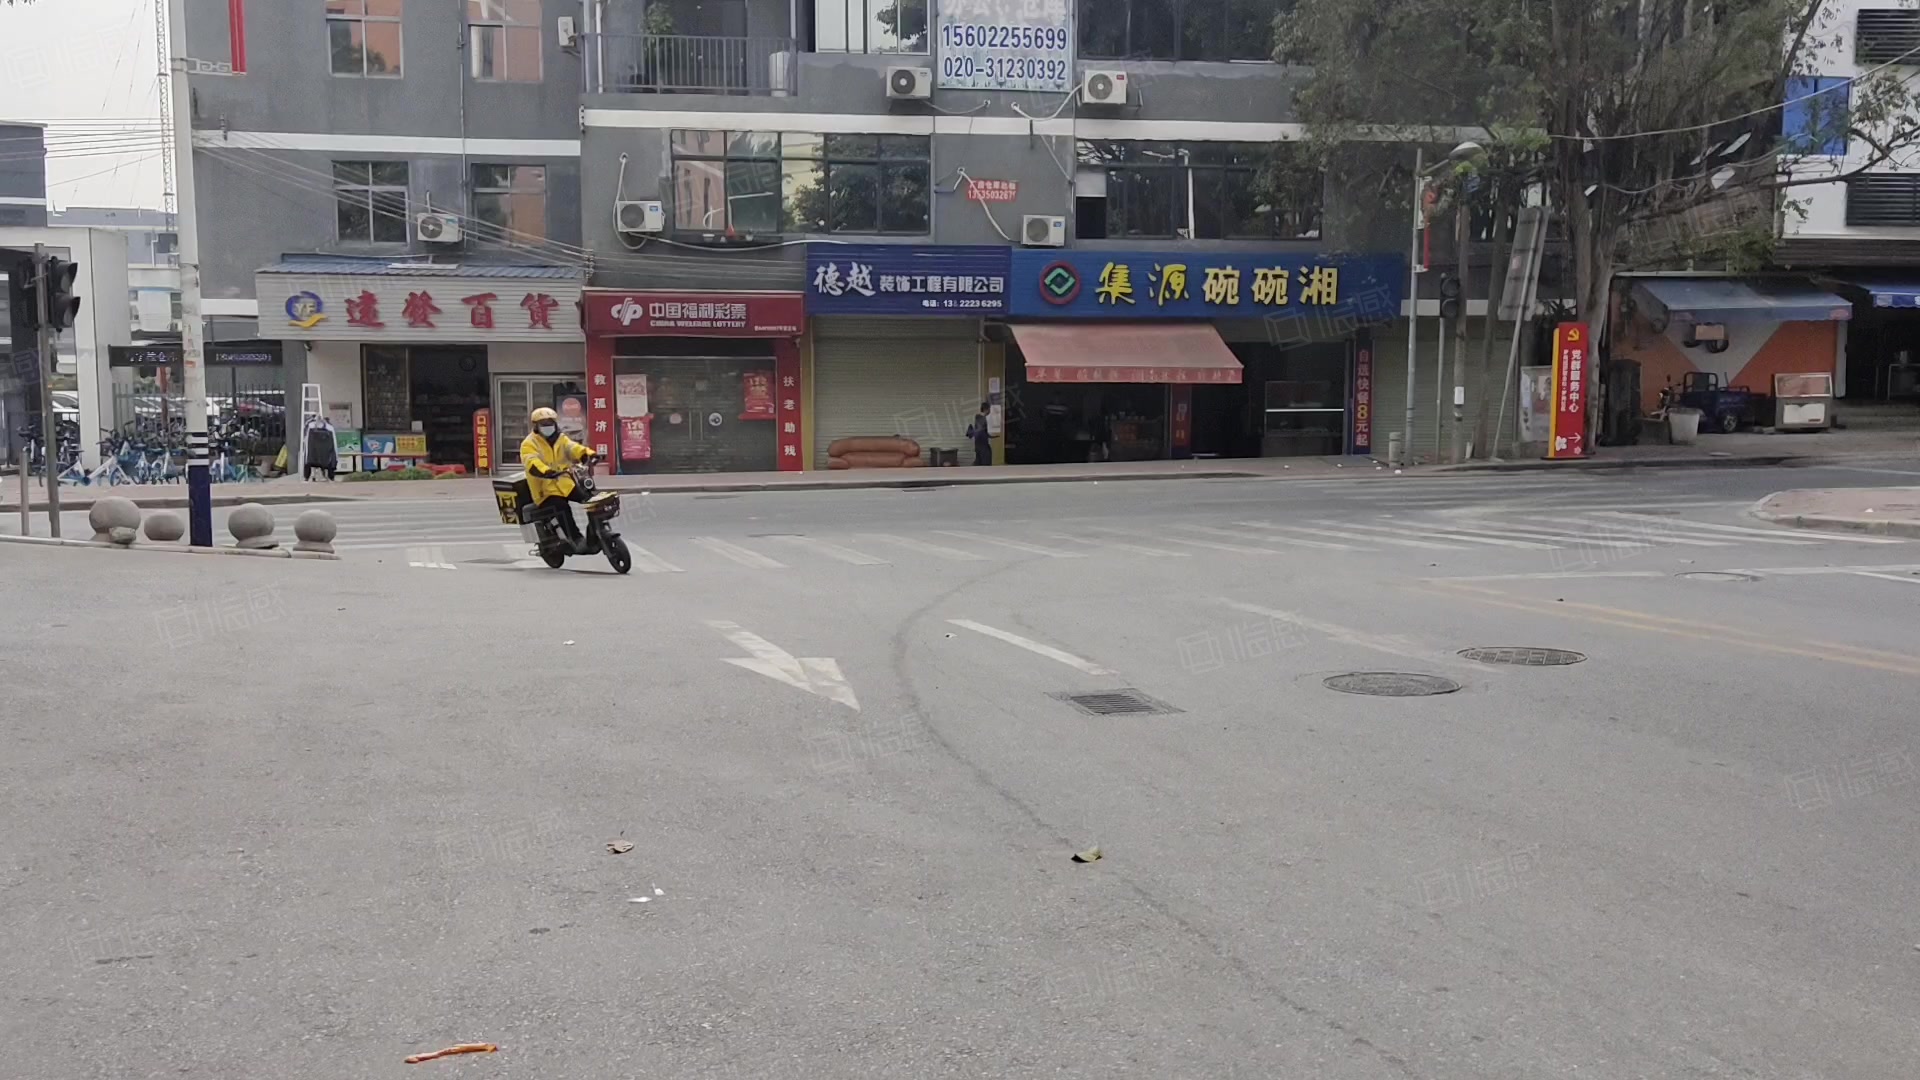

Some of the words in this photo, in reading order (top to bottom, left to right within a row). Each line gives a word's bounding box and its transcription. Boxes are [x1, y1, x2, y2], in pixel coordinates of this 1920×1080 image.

[942, 25, 1067, 50] 15602255699
[943, 57, 1067, 80] 020-31230392
[879, 275, 1004, 294] 装饰工程有限公司
[649, 302, 746, 319] 中国福利彩票
[713, 320, 746, 328] LOTTERY
[783, 375, 797, 457] 扶老助残
